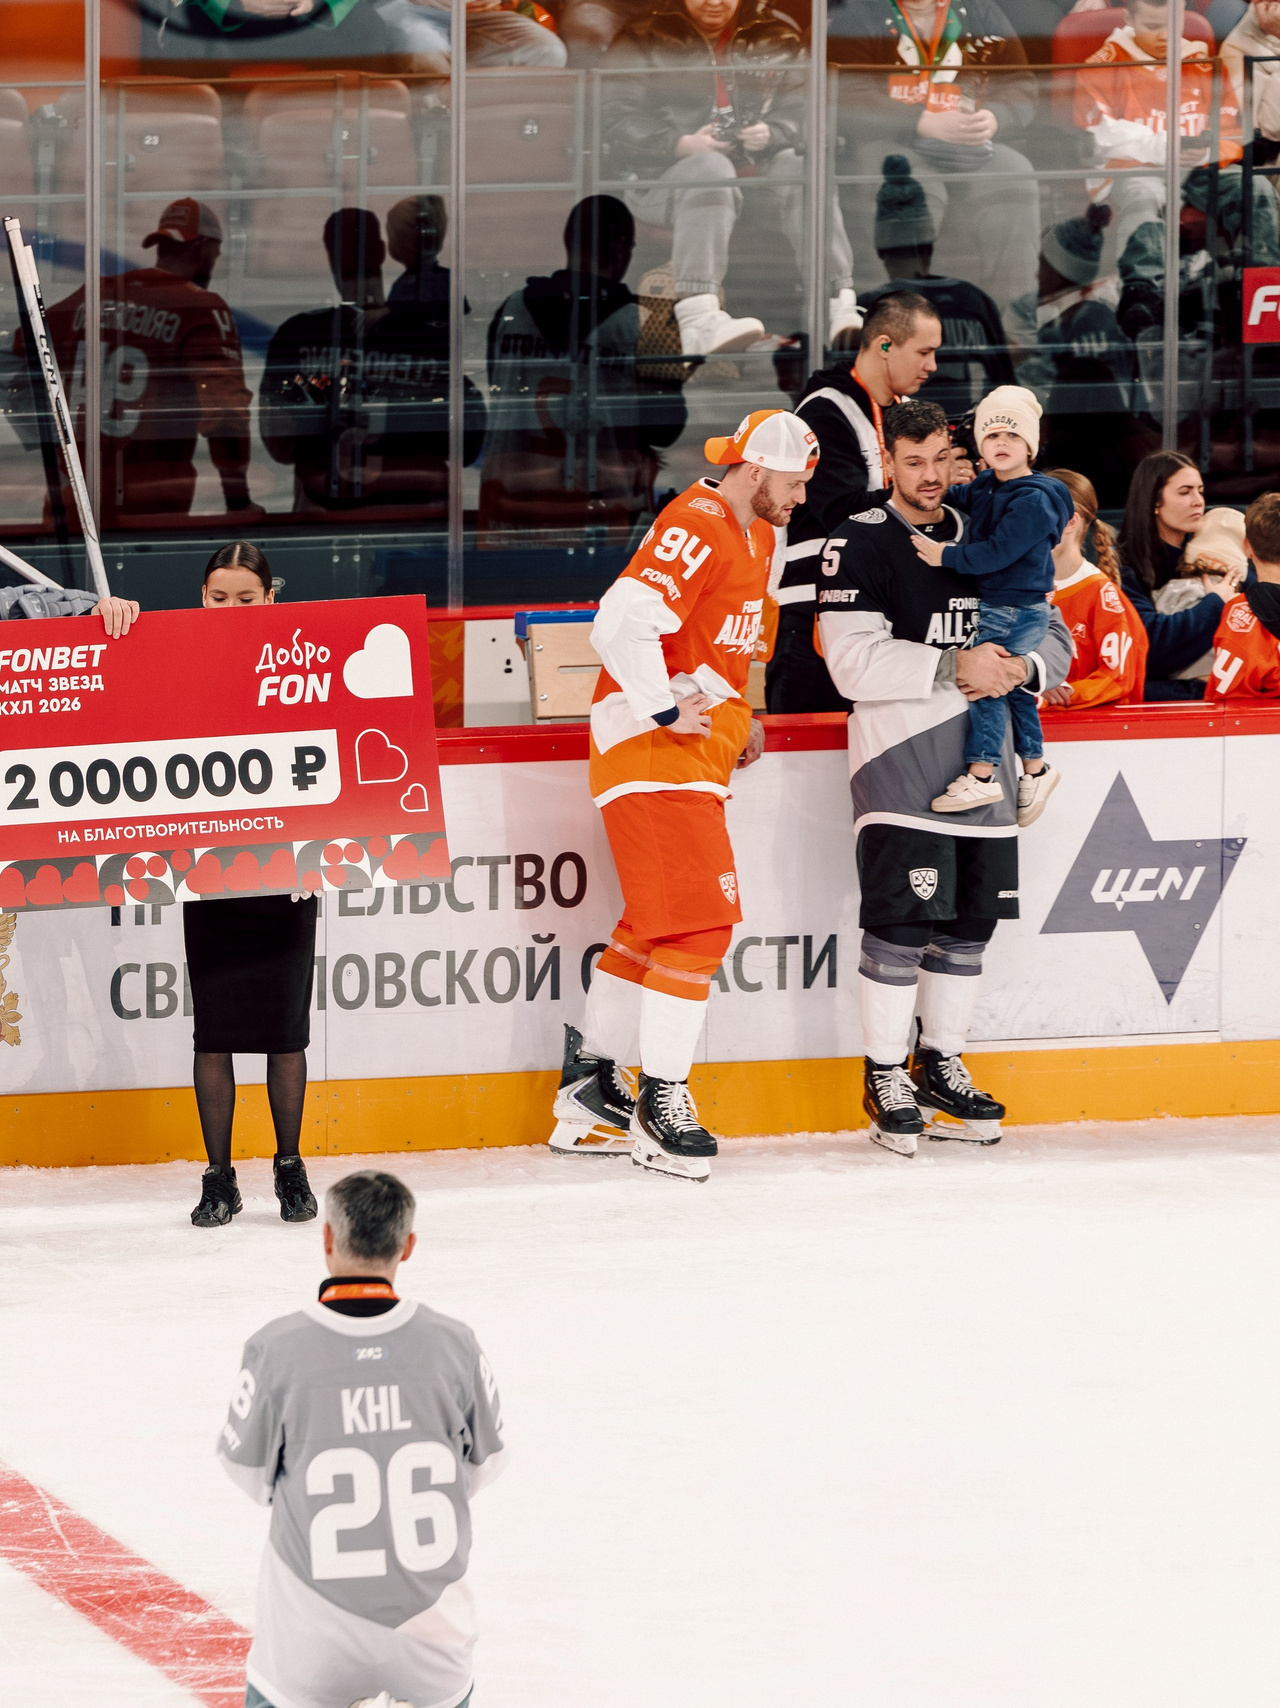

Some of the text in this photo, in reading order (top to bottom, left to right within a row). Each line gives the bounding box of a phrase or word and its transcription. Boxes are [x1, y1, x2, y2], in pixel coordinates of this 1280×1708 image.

[144, 135, 160, 146] 23
[1247, 285, 1280, 325] F
[39, 334, 57, 386] CCM
[654, 526, 712, 581] 94
[821, 538, 848, 577] 5
[639, 567, 682, 601] FONBET
[819, 589, 859, 603] NBET
[948, 597, 980, 611] FONB
[713, 614, 747, 645] ALL
[924, 611, 967, 644] ALL
[255, 628, 331, 673] Добро
[49, 674, 105, 693] ЗВЕЗД
[1212, 646, 1244, 695] 4
[39, 696, 81, 714] 2026
[257, 673, 333, 706] FON
[5, 745, 327, 810] 2 000 000 ₽
[57, 816, 284, 844] НА БЛАГОТВОРИТЕЛЬНОСТЬ
[109, 933, 837, 1020] СВОВСКОЙ ОСТИ
[646, 1120, 665, 1142] BAUER
[340, 1383, 412, 1436] KHL
[305, 1440, 458, 1581] 26
